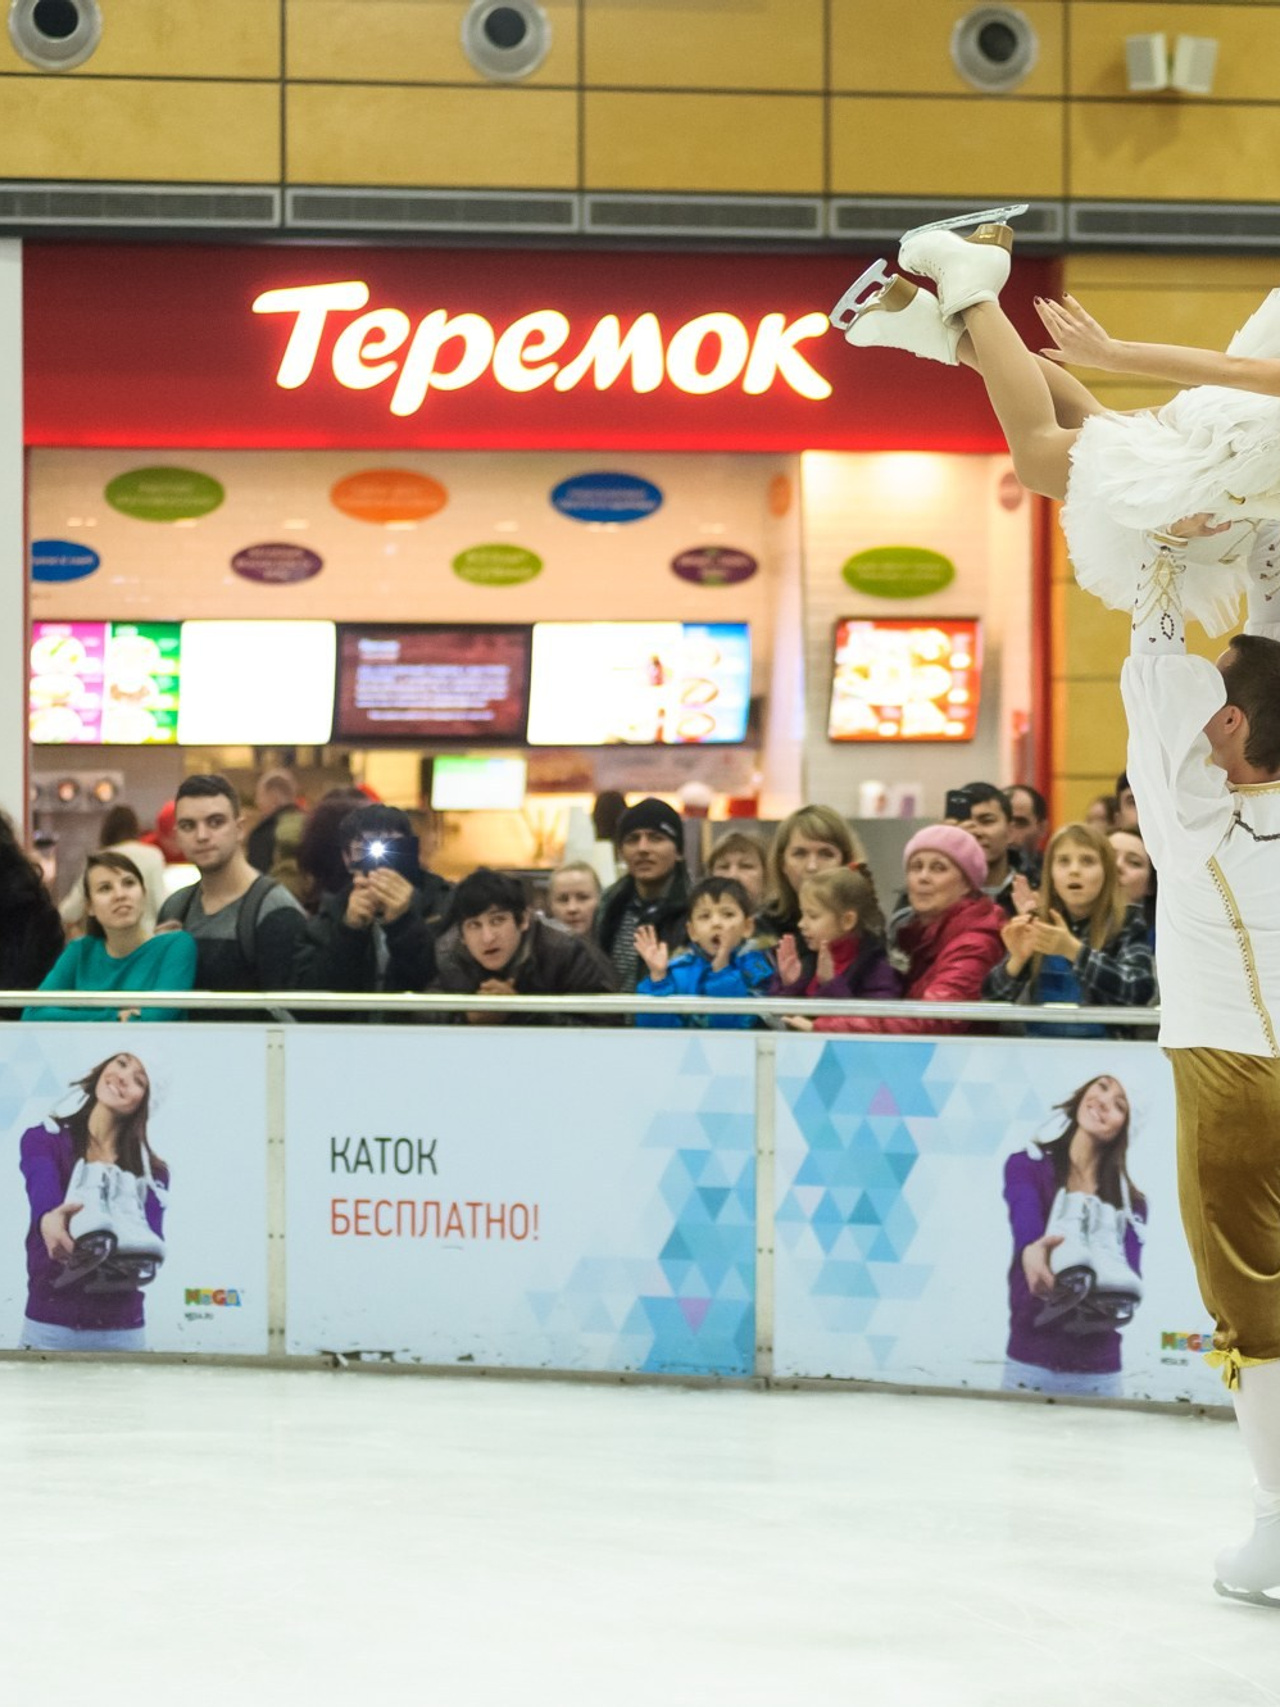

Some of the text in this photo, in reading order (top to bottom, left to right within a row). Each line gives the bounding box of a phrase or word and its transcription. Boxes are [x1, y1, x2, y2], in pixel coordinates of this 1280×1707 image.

[252, 281, 833, 416] Теремок
[330, 1137, 438, 1175] КАТОК
[330, 1198, 539, 1241] БЕСПЛАТНО!
